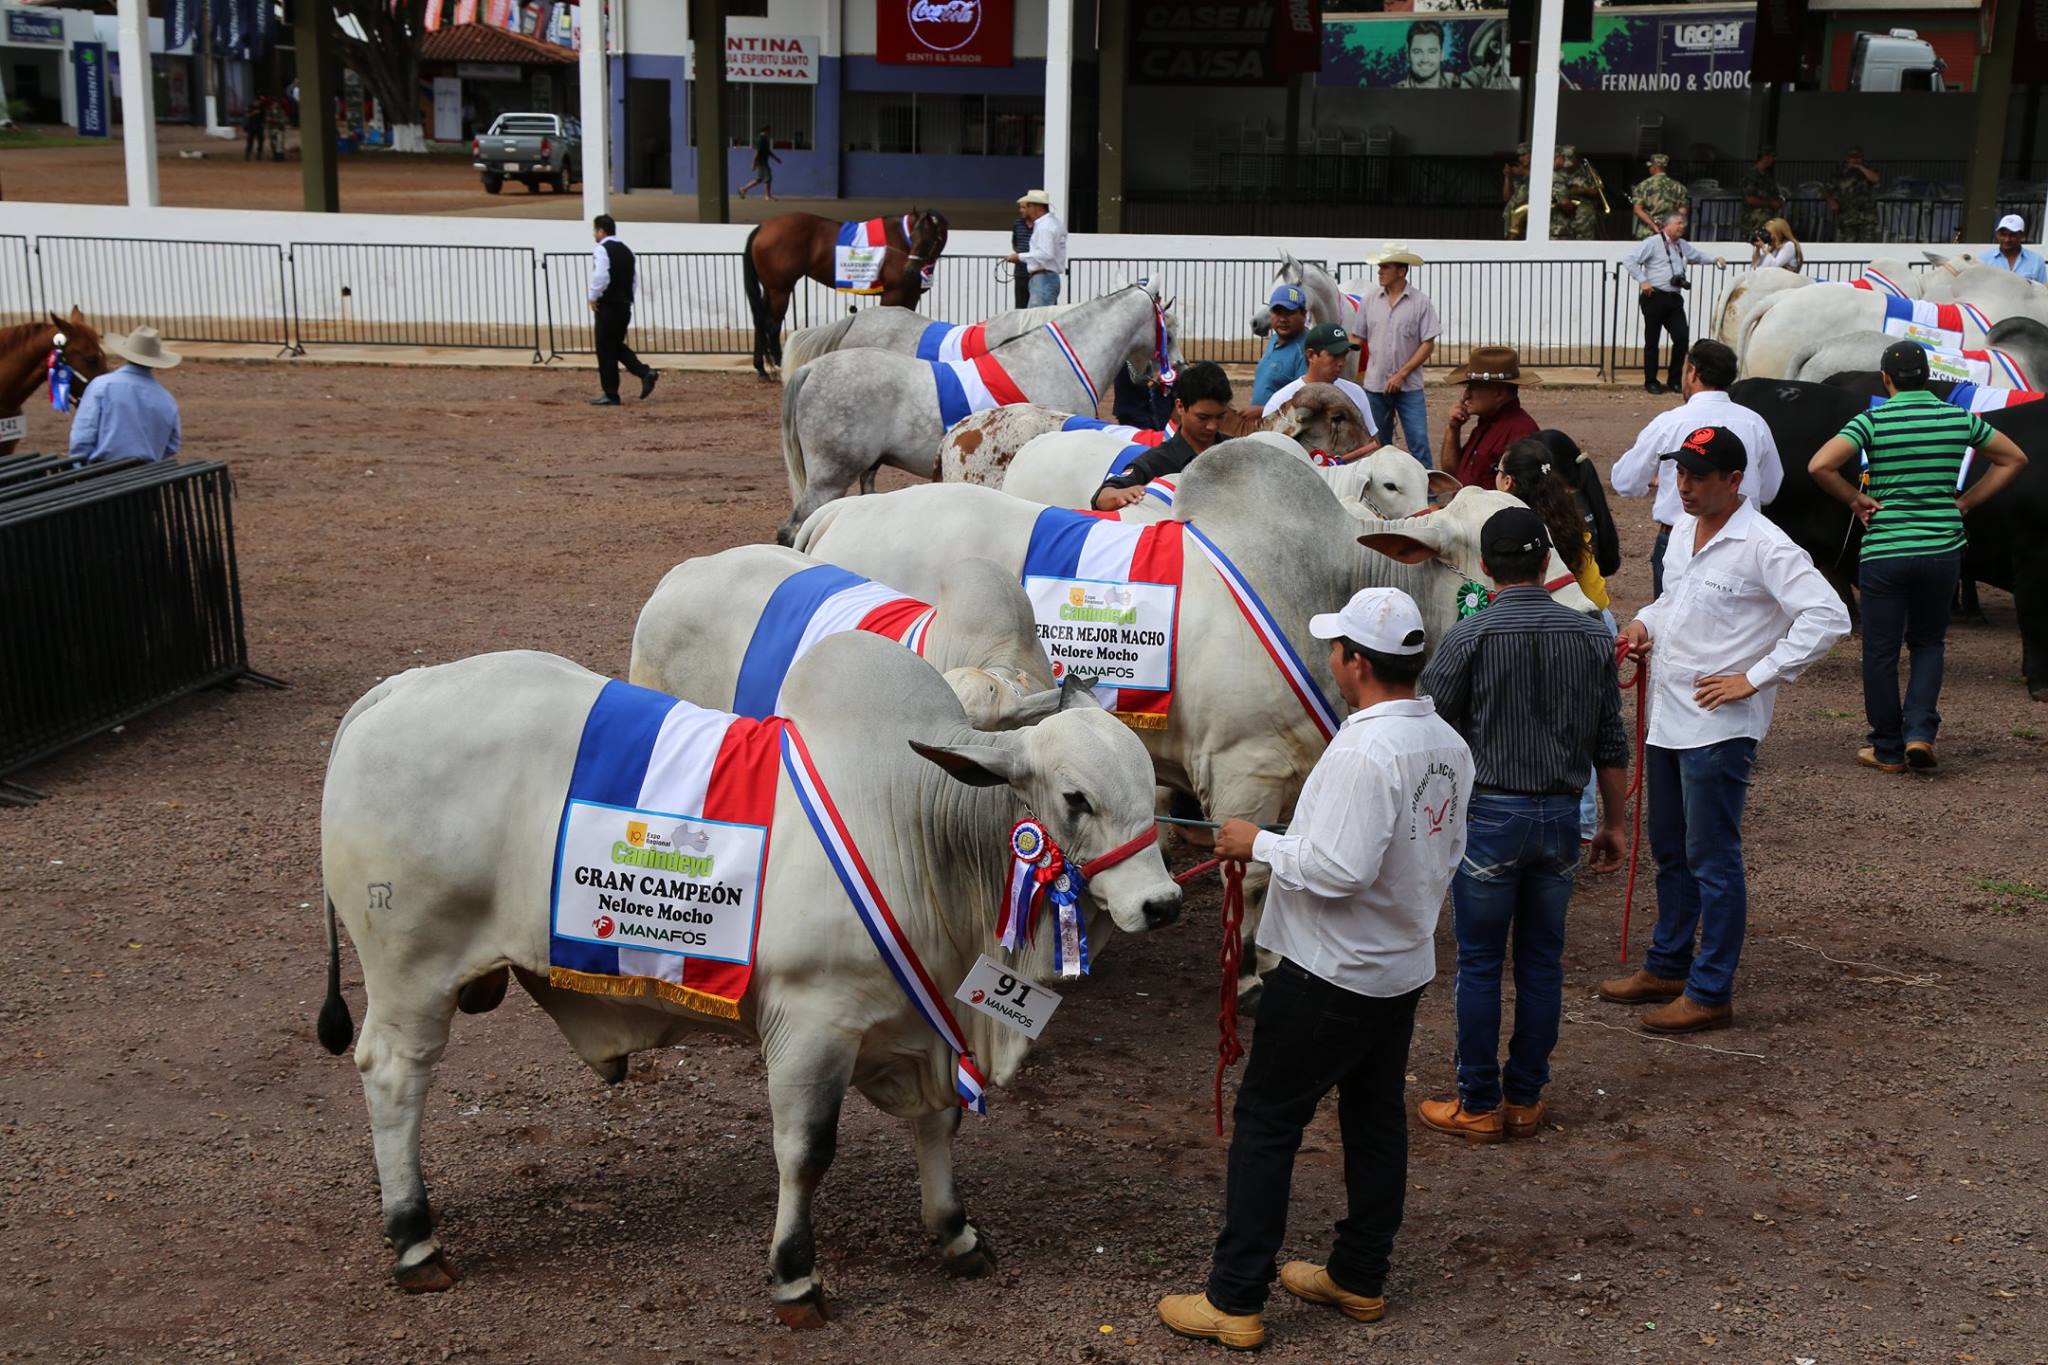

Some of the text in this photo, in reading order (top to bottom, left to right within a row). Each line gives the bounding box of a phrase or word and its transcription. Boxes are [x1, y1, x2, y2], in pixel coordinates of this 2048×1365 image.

[1144, 6, 1240, 28] CASE
[1675, 21, 1743, 48] LAGOA
[781, 54, 809, 66] SANTO
[949, 53, 982, 63] SABOR
[1602, 72, 1681, 91] FERNANDO
[1686, 73, 1697, 91] &
[1034, 624, 1165, 646] ERCER MEJOR MACHO
[1050, 643, 1139, 662] Nelore Mocho
[1067, 664, 1135, 679] MANAFOS
[610, 839, 715, 879] Canindeyú
[574, 866, 743, 906] GRAN CAMPEÓN
[598, 893, 714, 925] Nelore Mocho
[993, 973, 1032, 1009] 91
[984, 996, 1034, 1029] MANAFOS
